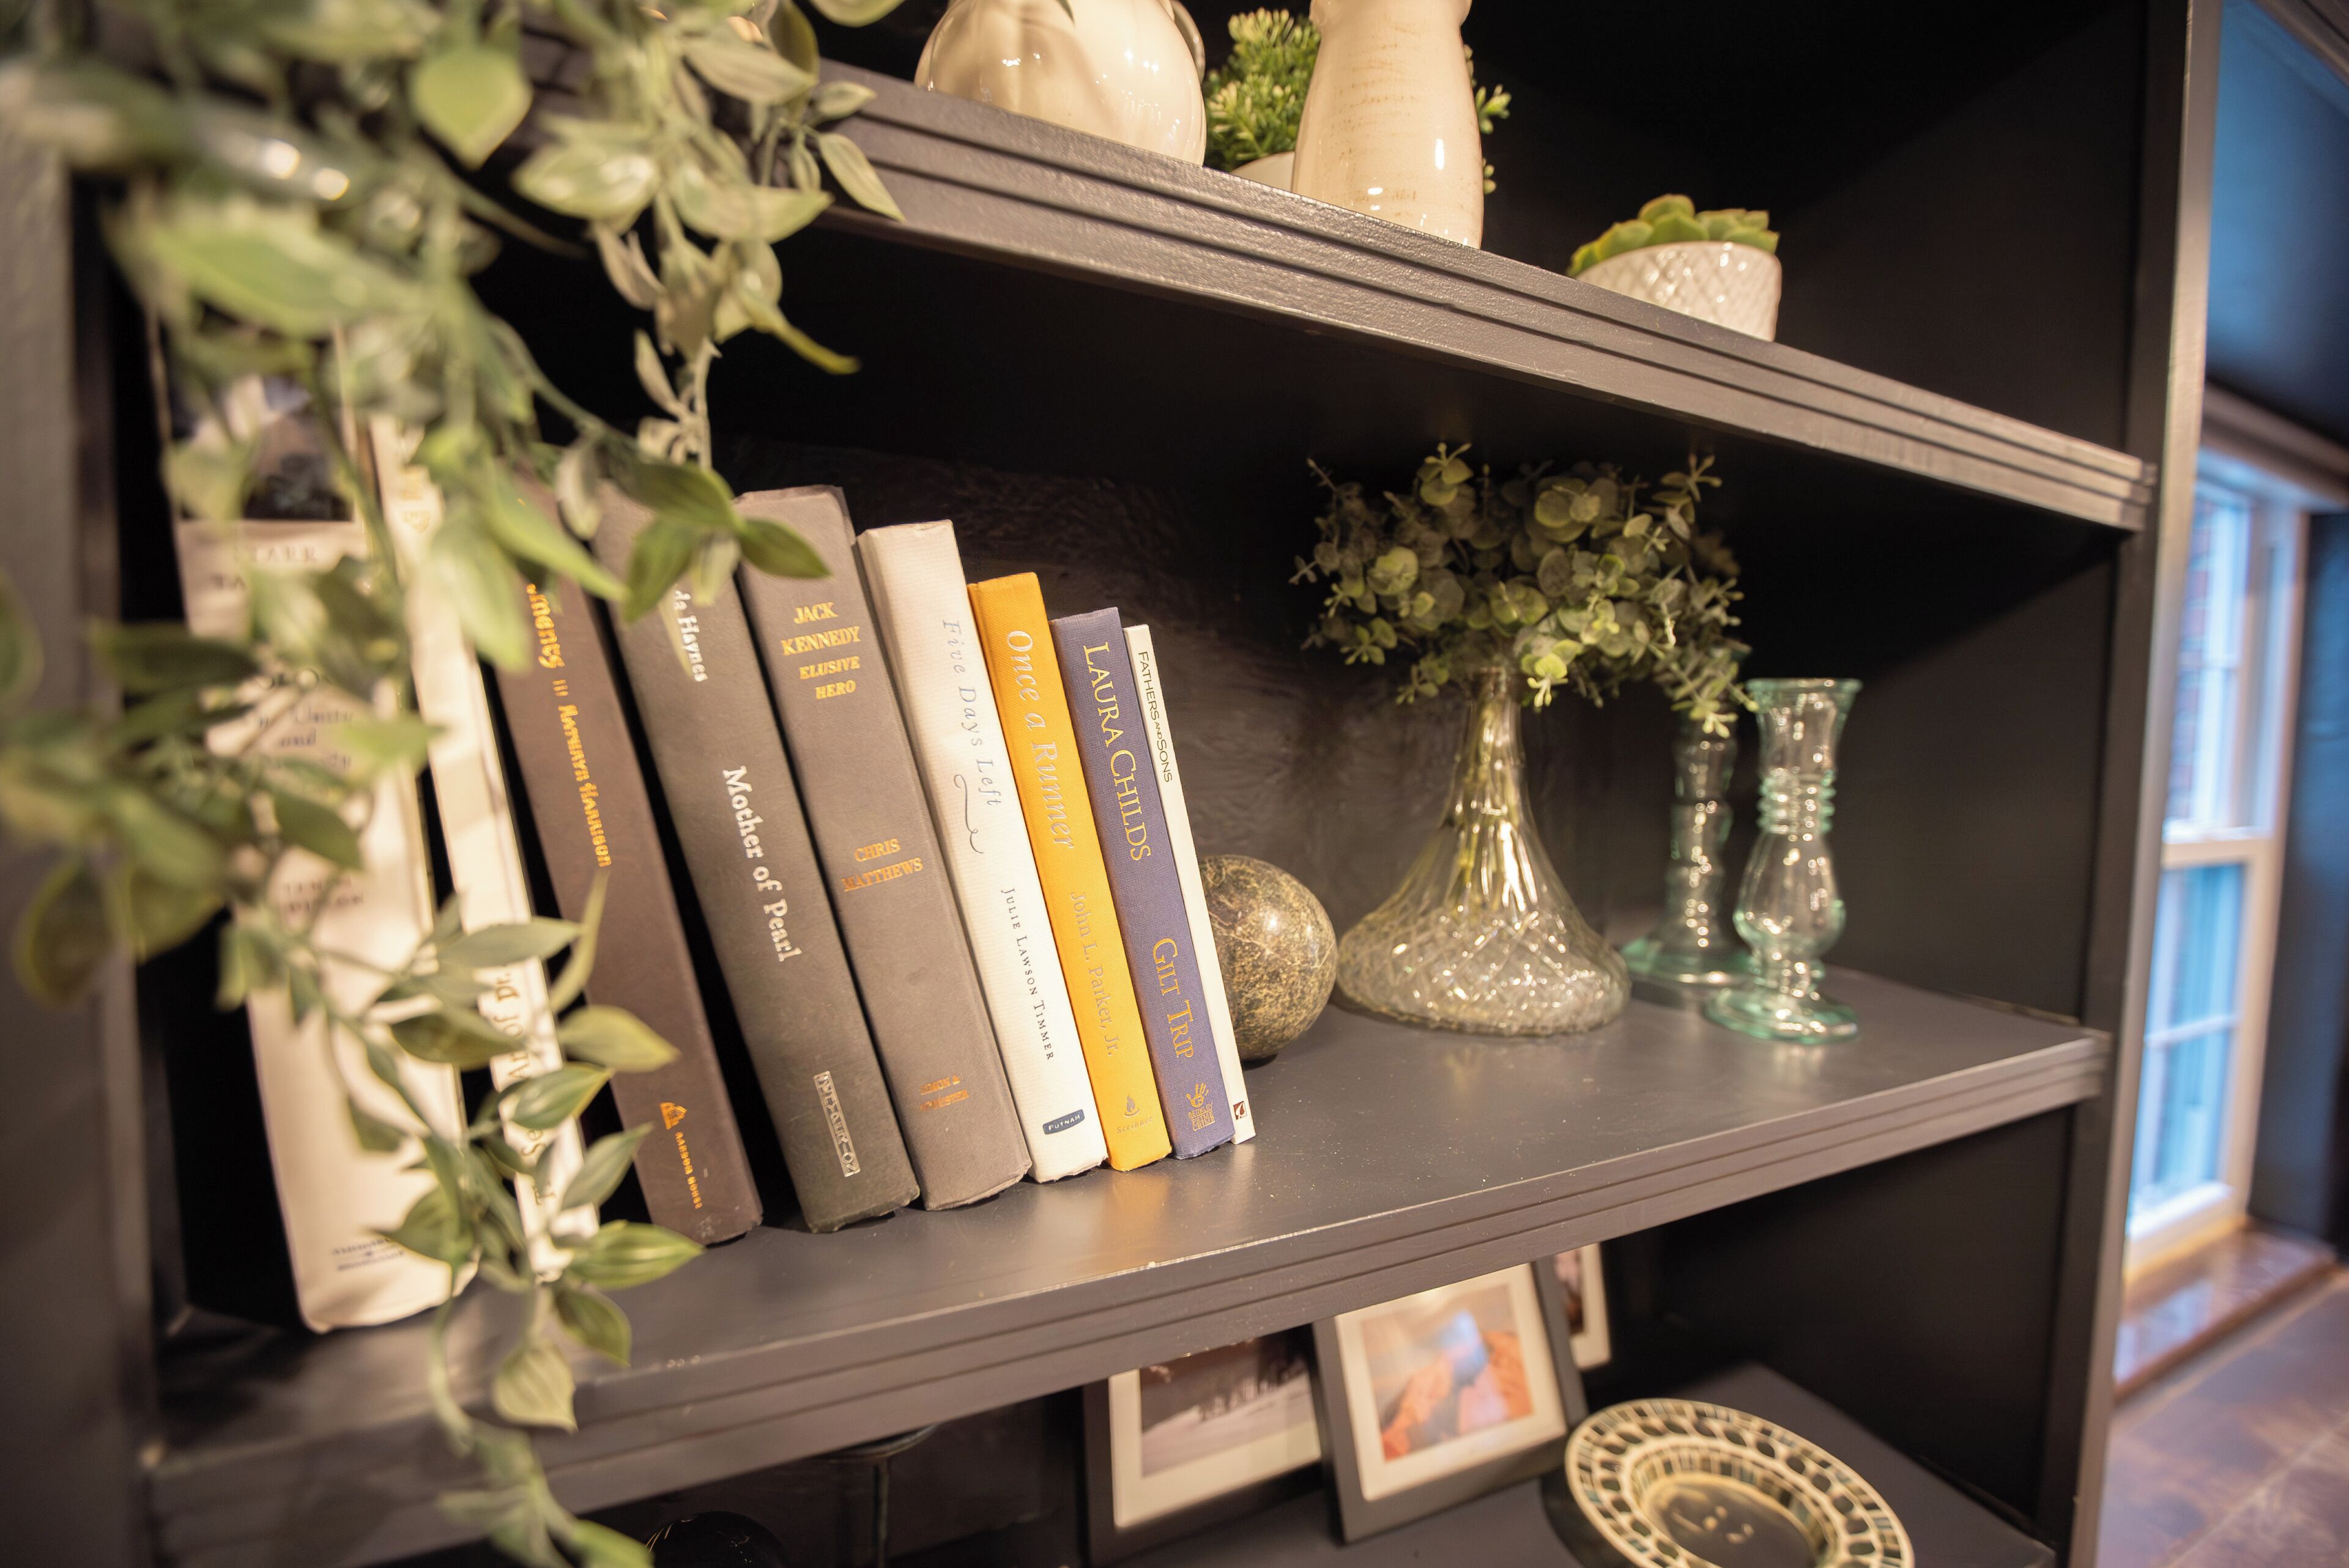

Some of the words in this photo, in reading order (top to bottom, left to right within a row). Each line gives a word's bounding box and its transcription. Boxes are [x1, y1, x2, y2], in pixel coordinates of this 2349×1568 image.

[793, 601, 839, 624] JACK
[678, 615, 708, 682] Haynes
[780, 626, 861, 656] KENNEDY
[800, 656, 860, 679] ELUSIVE
[1007, 630, 1040, 701] Once
[815, 680, 856, 700] HERO
[942, 619, 966, 674] Five
[959, 686, 983, 746] Days
[976, 758, 1001, 807] Left
[1024, 712, 1047, 730] a
[1138, 651, 1159, 720] FATHERS
[1157, 739, 1173, 783] SONS
[1083, 642, 1124, 747] LAURA
[1110, 750, 1151, 861] CHILDS
[1031, 741, 1074, 849] Runner
[723, 766, 764, 859] Mother
[855, 838, 901, 862] CHRIS
[753, 866, 783, 892] of
[841, 858, 923, 892] MATTHEWS
[763, 898, 802, 962] Pearl
[1071, 892, 1091, 939] John
[1082, 942, 1098, 961] L.
[1001, 887, 1021, 929] JULIE
[1017, 936, 1037, 996] LAWSON
[1034, 1000, 1054, 1060] TIMMER
[1088, 966, 1112, 1029] Parker,
[1152, 938, 1181, 996] GILT
[1167, 999, 1194, 1058] TRIP
[493, 1011, 523, 1038] of
[1104, 1035, 1119, 1057] Jr.
[1048, 1114, 1081, 1131] PUTNAM
[1116, 1116, 1154, 1133] Scribner
